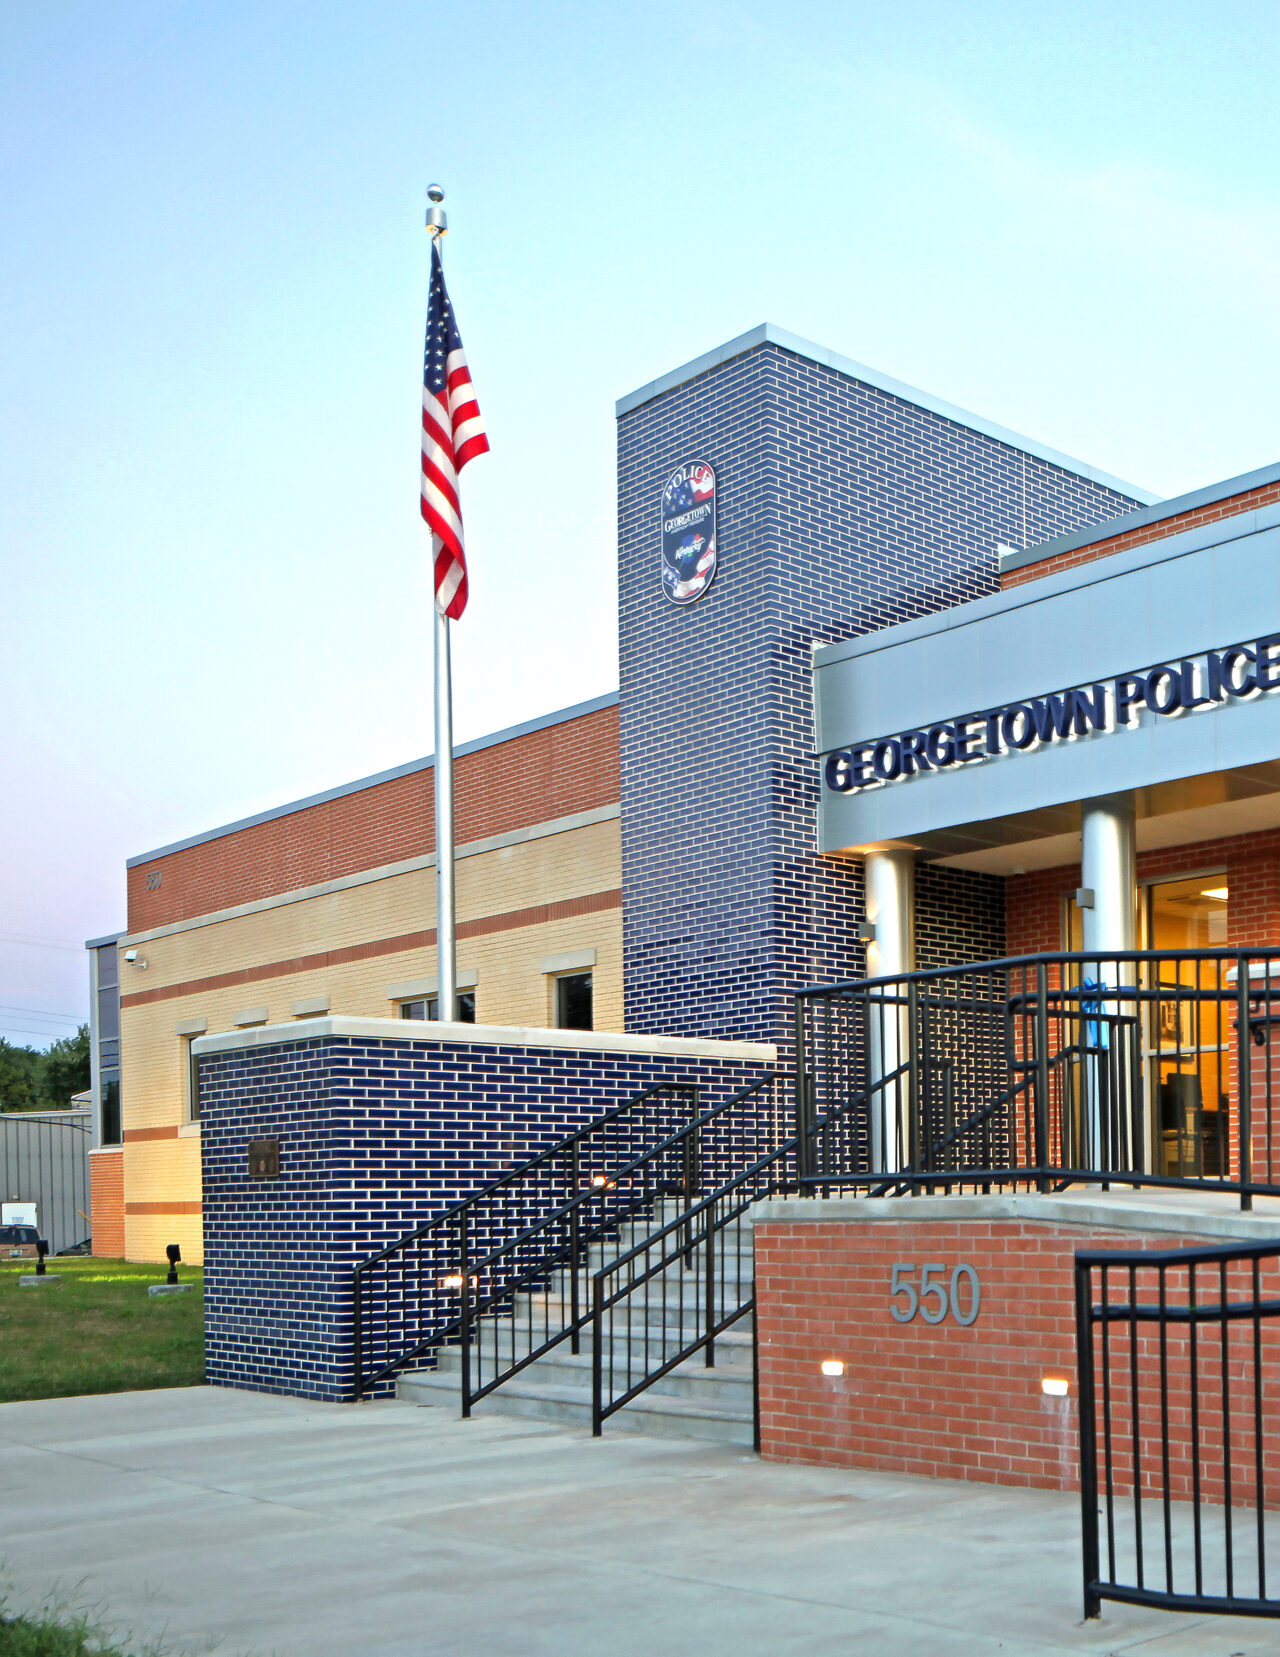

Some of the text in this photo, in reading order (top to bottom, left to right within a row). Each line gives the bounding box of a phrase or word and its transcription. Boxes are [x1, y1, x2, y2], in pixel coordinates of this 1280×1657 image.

[665, 465, 712, 501] POLICE
[825, 684, 1107, 793] GEORGETOWN
[890, 1262, 980, 1326] 550
